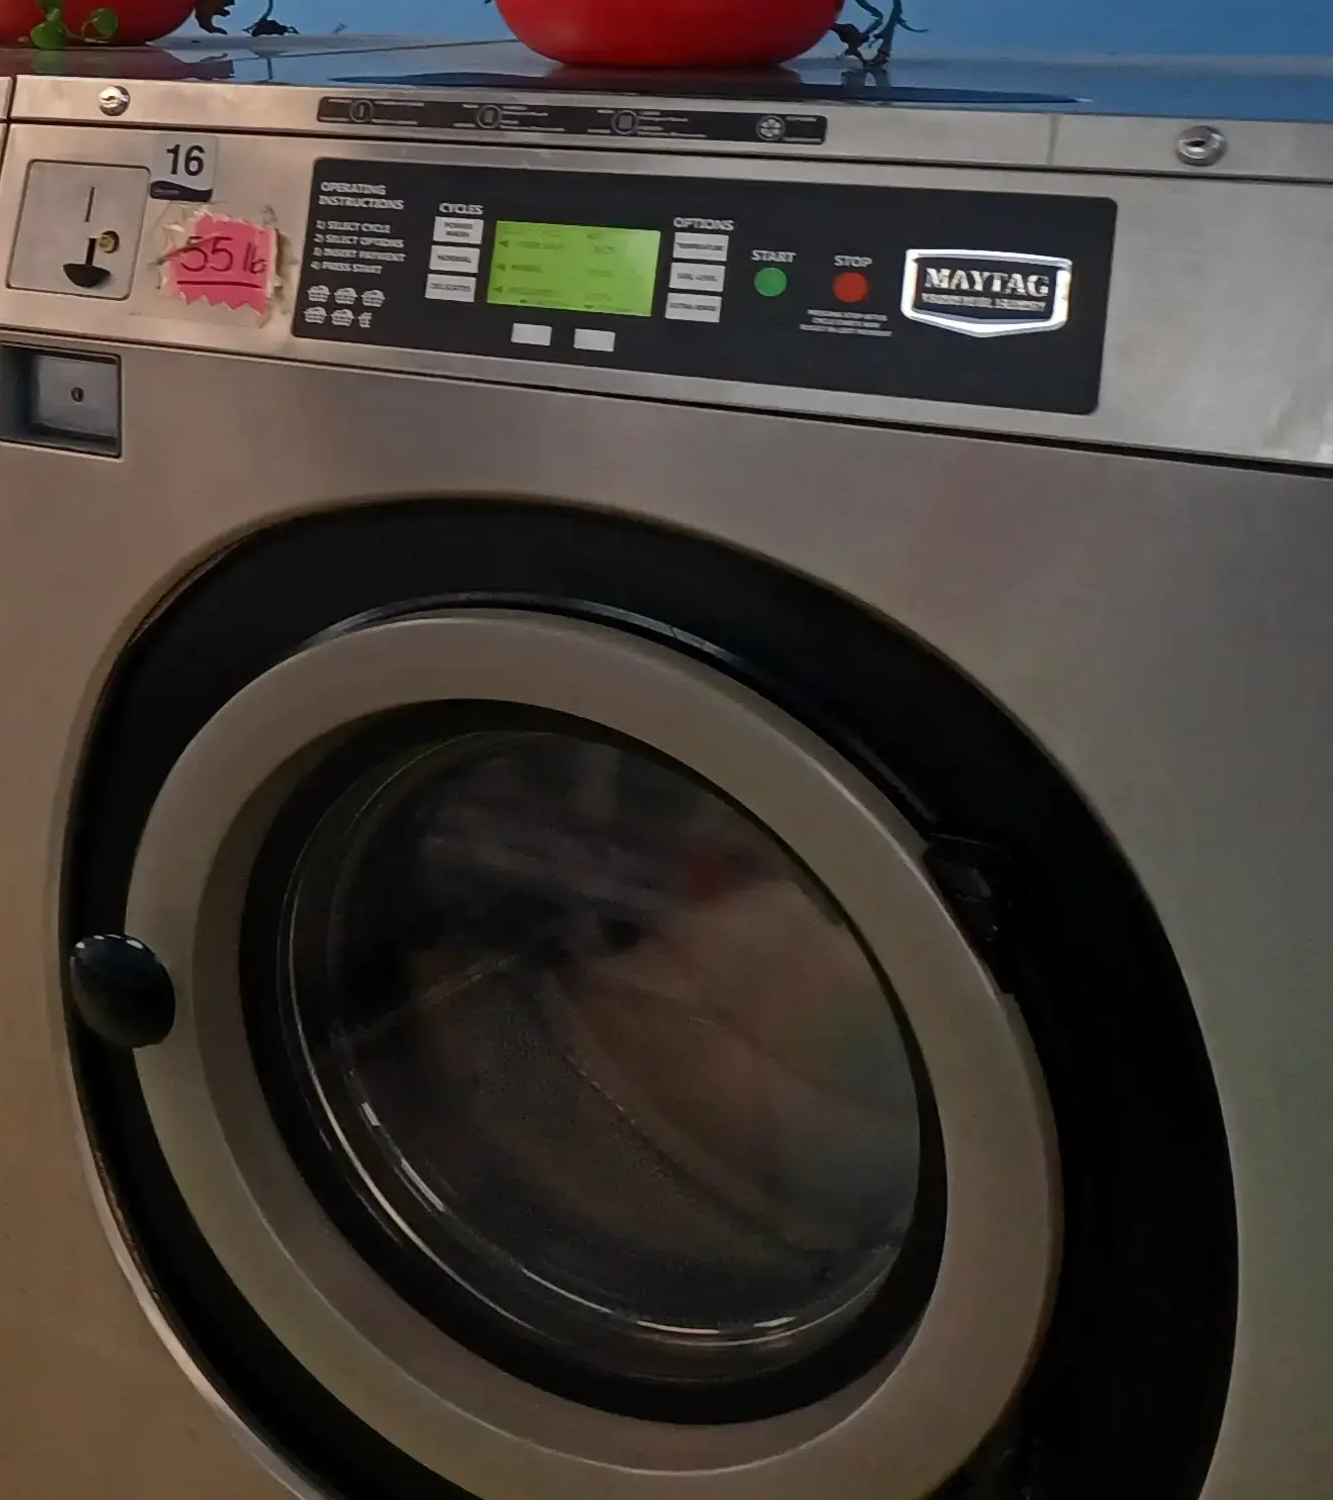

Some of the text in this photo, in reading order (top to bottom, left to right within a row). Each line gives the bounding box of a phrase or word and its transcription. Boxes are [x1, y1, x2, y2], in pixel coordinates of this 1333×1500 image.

[166, 144, 206, 177] 16
[320, 181, 387, 195] OPERATING
[318, 195, 405, 210] INSTRUCTIONS
[439, 202, 484, 215] CYCLES
[673, 217, 734, 231] OPTIONS
[180, 235, 268, 275] 55 lb
[751, 249, 797, 264] START
[834, 255, 873, 268] STOP
[924, 267, 1050, 298] MAYTAG
